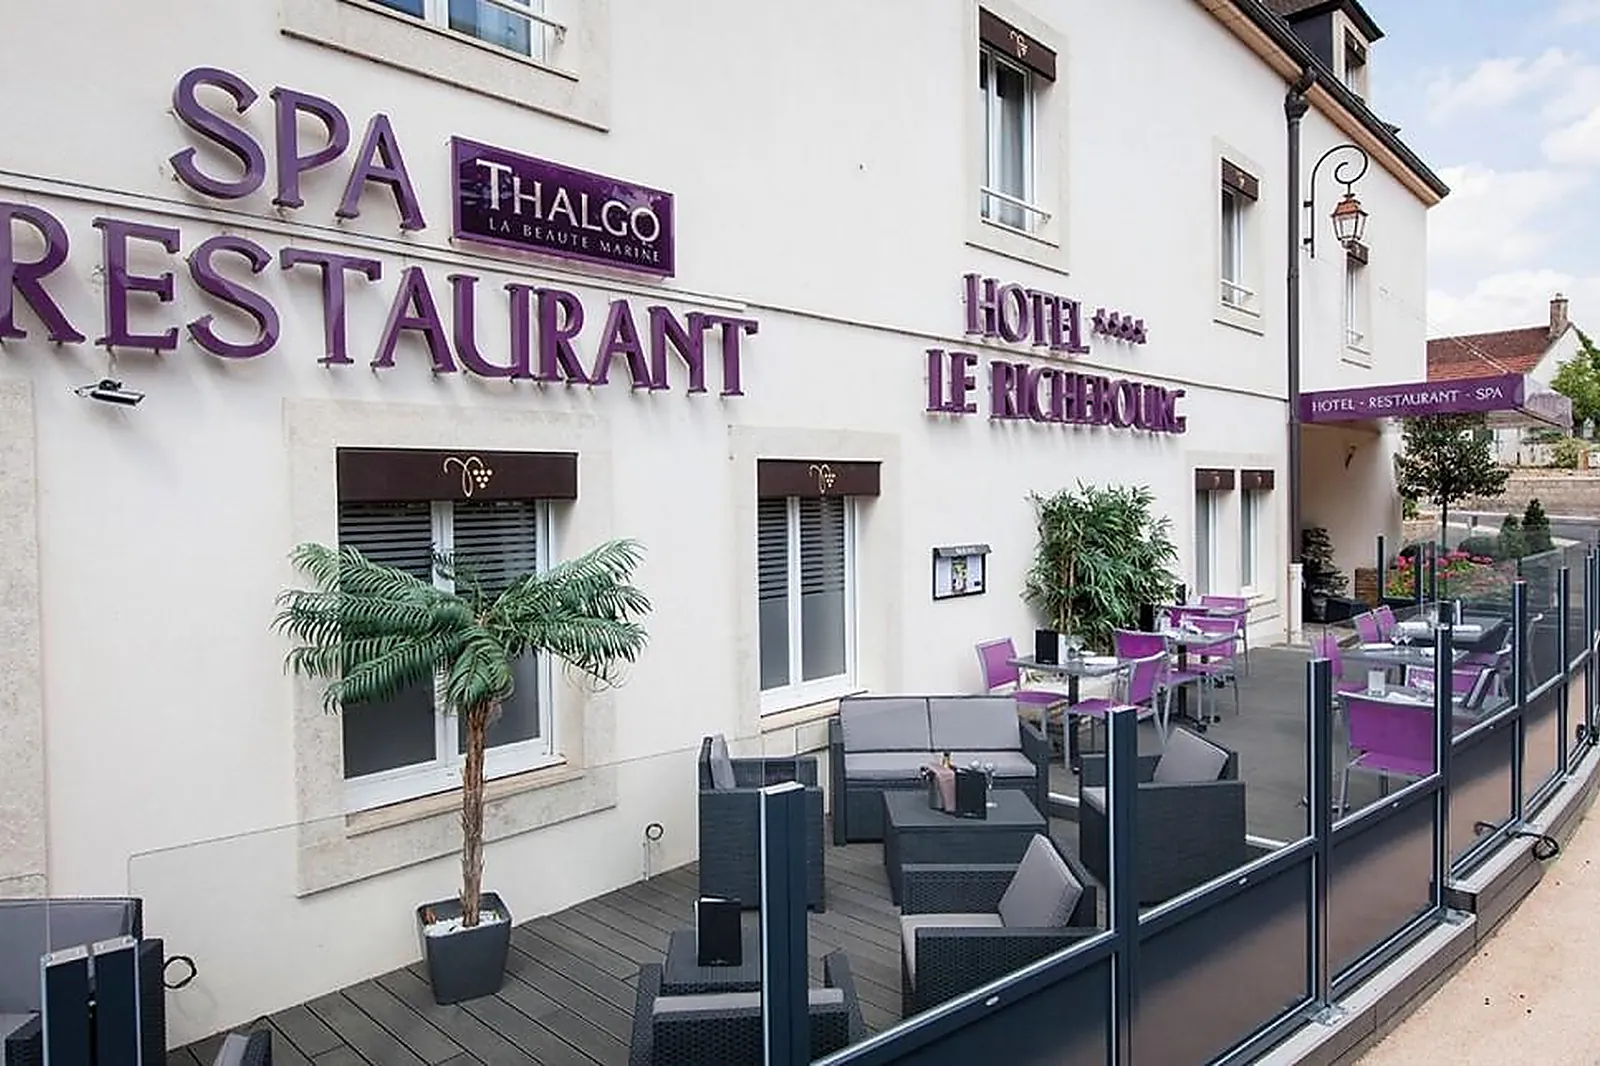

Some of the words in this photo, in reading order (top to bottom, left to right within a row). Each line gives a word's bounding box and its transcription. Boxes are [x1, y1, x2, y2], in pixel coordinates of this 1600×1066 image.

[169, 66, 426, 231] SPA
[476, 158, 660, 242] THALGO
[488, 216, 512, 233] LA
[600, 240, 660, 262] MARINE
[0, 201, 760, 398] RESTAURANT
[963, 273, 1091, 355] HOTEL
[924, 348, 979, 414] LE
[989, 360, 1187, 434] RICHEBOURG
[1311, 398, 1356, 413] HOTEL
[1369, 390, 1459, 409] RESTAURANT
[1475, 386, 1504, 401] SPA
